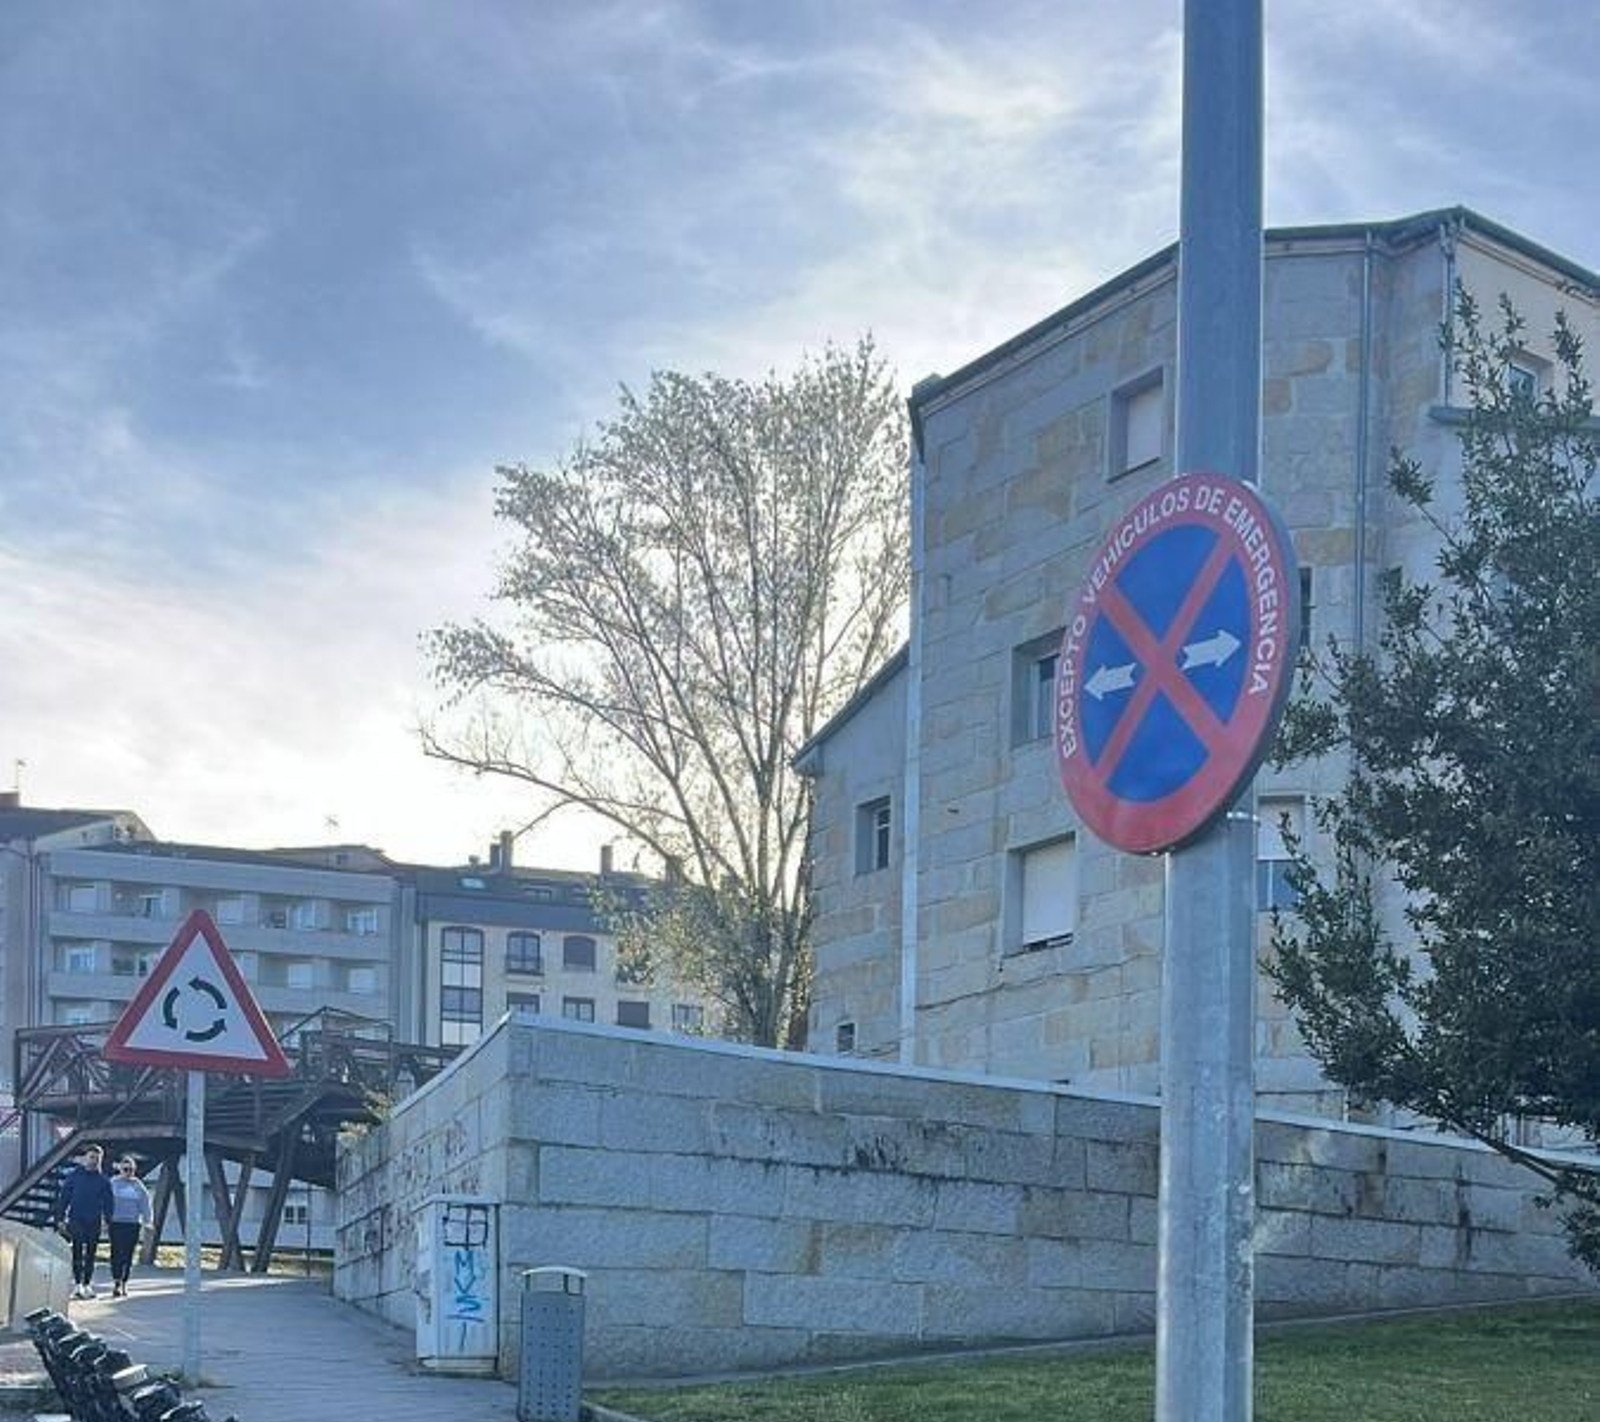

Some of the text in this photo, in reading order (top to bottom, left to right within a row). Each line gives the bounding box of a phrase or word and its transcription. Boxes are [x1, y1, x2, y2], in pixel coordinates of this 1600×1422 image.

[1059, 484, 1282, 759] EXCEPTO VEHICULOS DE EMERGENCIA
